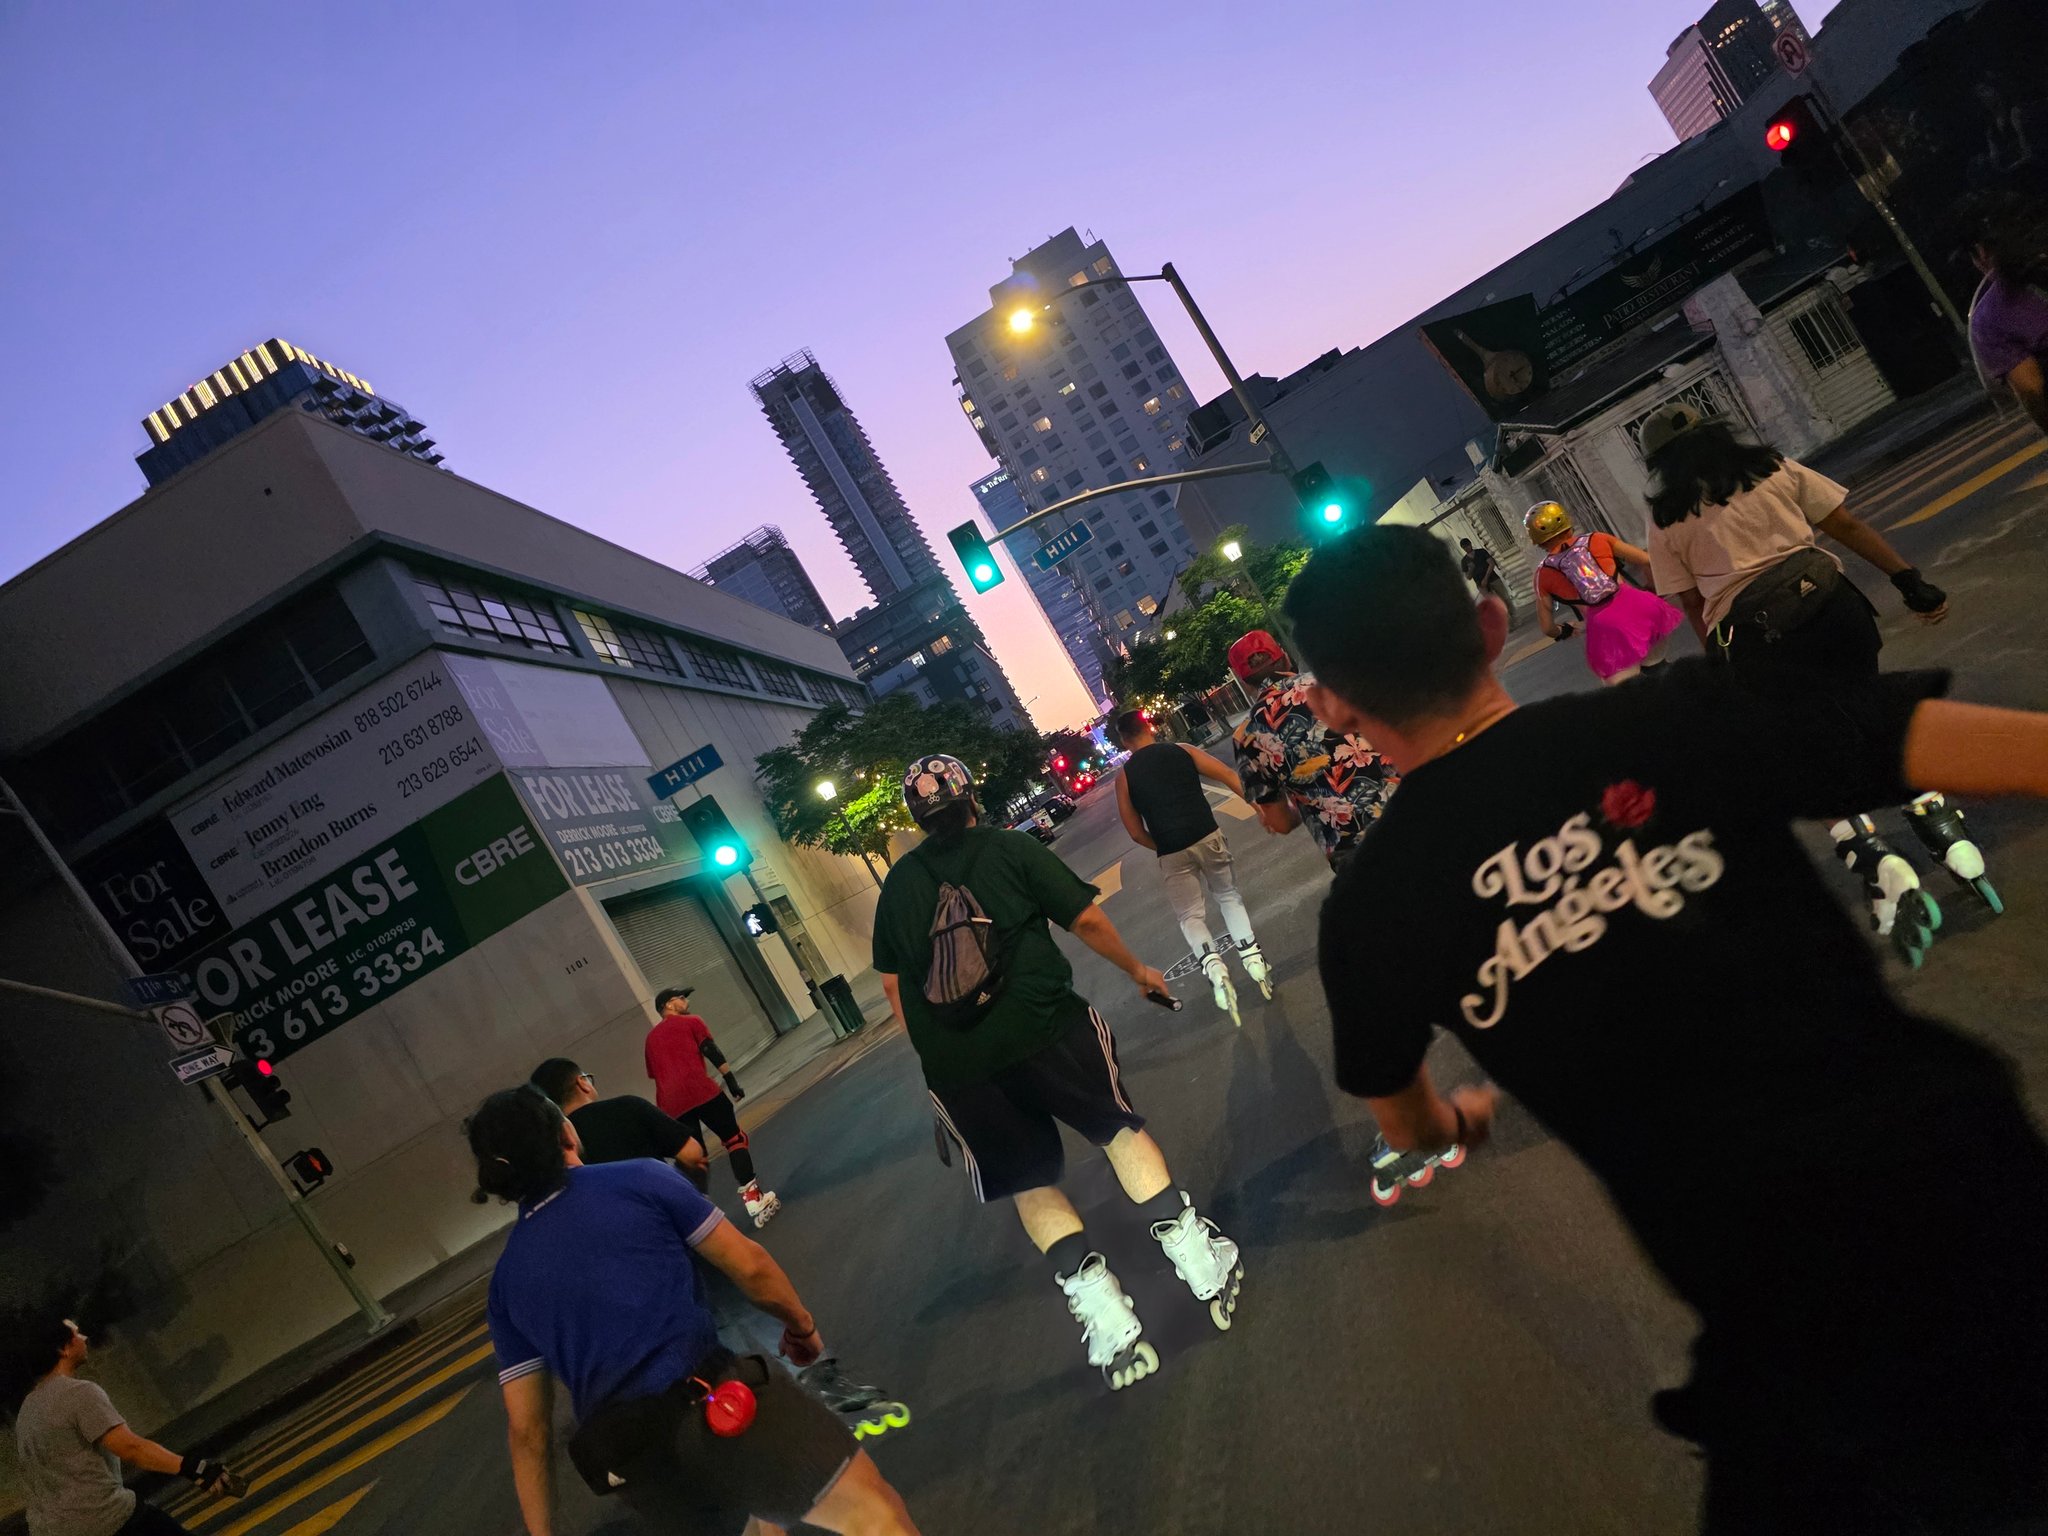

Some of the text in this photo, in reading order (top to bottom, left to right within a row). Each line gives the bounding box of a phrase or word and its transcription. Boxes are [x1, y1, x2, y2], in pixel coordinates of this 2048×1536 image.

[1602, 303, 1635, 329] PATIO
[1636, 262, 1701, 309] RESTAURANT
[1045, 531, 1078, 559] Hill
[456, 673, 505, 710] For
[222, 770, 277, 813] Edward
[273, 729, 353, 783] Matevosian
[354, 708, 381, 733] 818
[378, 691, 408, 718] 502
[406, 671, 442, 701] 6744
[484, 716, 538, 753] Sale
[244, 813, 289, 849] Jenny
[289, 793, 325, 819] Eng
[378, 740, 405, 765] 213
[403, 724, 430, 750] 631
[427, 705, 463, 735] 8788
[521, 774, 640, 821] FOR LEASE
[664, 755, 706, 787] Hill
[261, 832, 330, 878] Brandon
[328, 802, 378, 838] Burns
[397, 772, 423, 798] 213
[421, 757, 449, 783] 629
[448, 736, 484, 767] 6541
[555, 827, 592, 844] DERRICK
[588, 823, 619, 840] MOORE
[652, 804, 682, 823] CBRE
[210, 847, 240, 870] CBRE
[455, 824, 536, 886] CBRE
[564, 835, 666, 876] 213 613 3334
[1472, 811, 1602, 908] Los
[101, 860, 173, 917] For
[269, 847, 419, 966] LEASE
[127, 897, 215, 961] Sale
[1459, 827, 1726, 1029] Angeles
[275, 957, 341, 1006] MOORE
[366, 917, 416, 952] 01029938
[283, 984, 350, 1041] 613
[353, 926, 445, 997] 3334
[565, 957, 588, 975] 1101
[181, 1053, 220, 1076] ONE WAY
